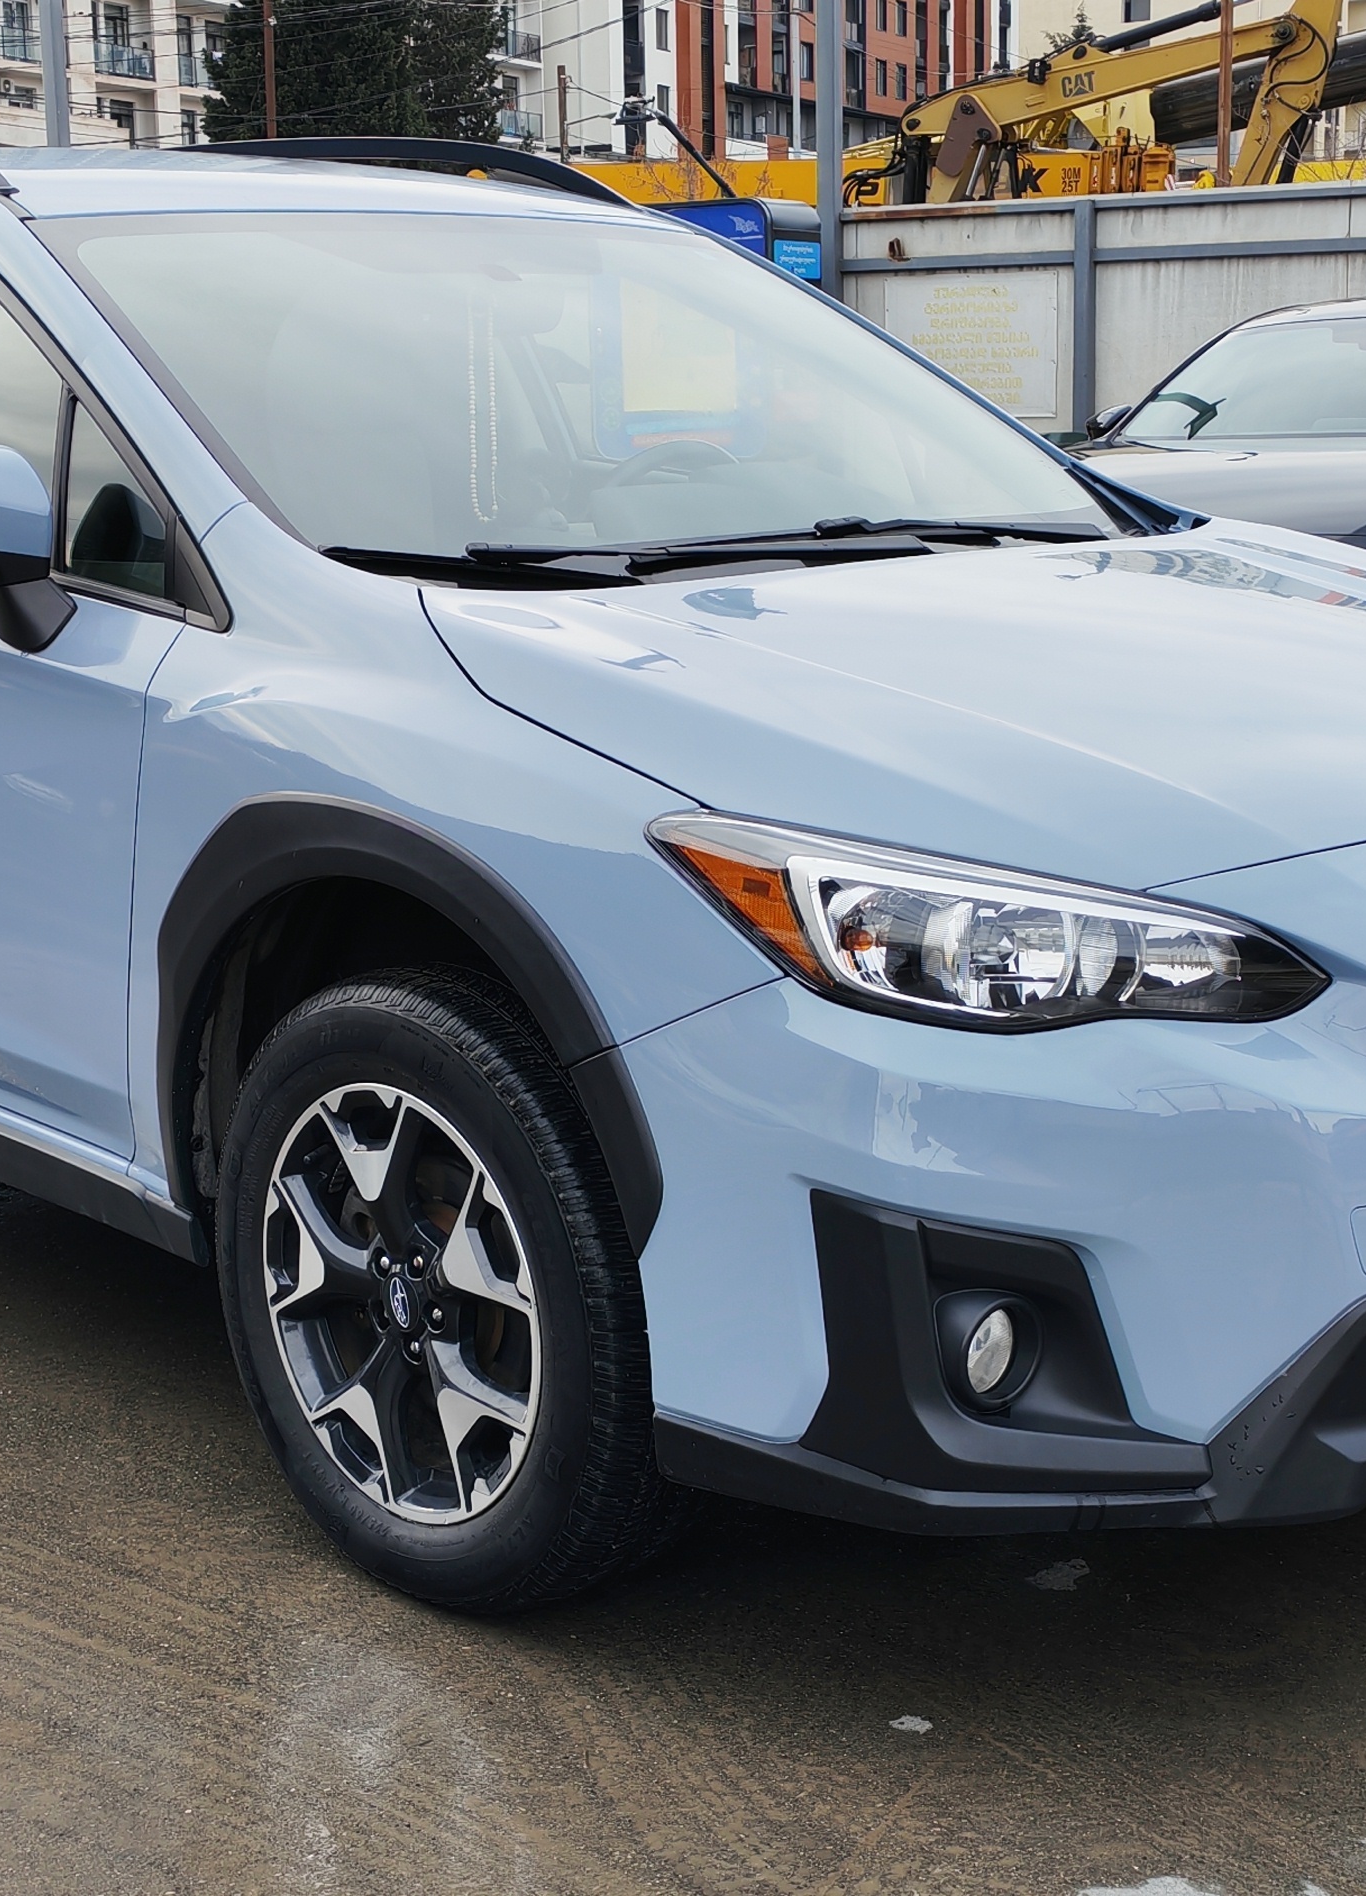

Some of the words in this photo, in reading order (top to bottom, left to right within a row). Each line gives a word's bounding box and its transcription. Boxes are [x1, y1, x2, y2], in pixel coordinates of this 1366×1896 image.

[1061, 70, 1096, 98] CAT
[1061, 167, 1081, 180] 30M
[1061, 180, 1081, 193] 25T
